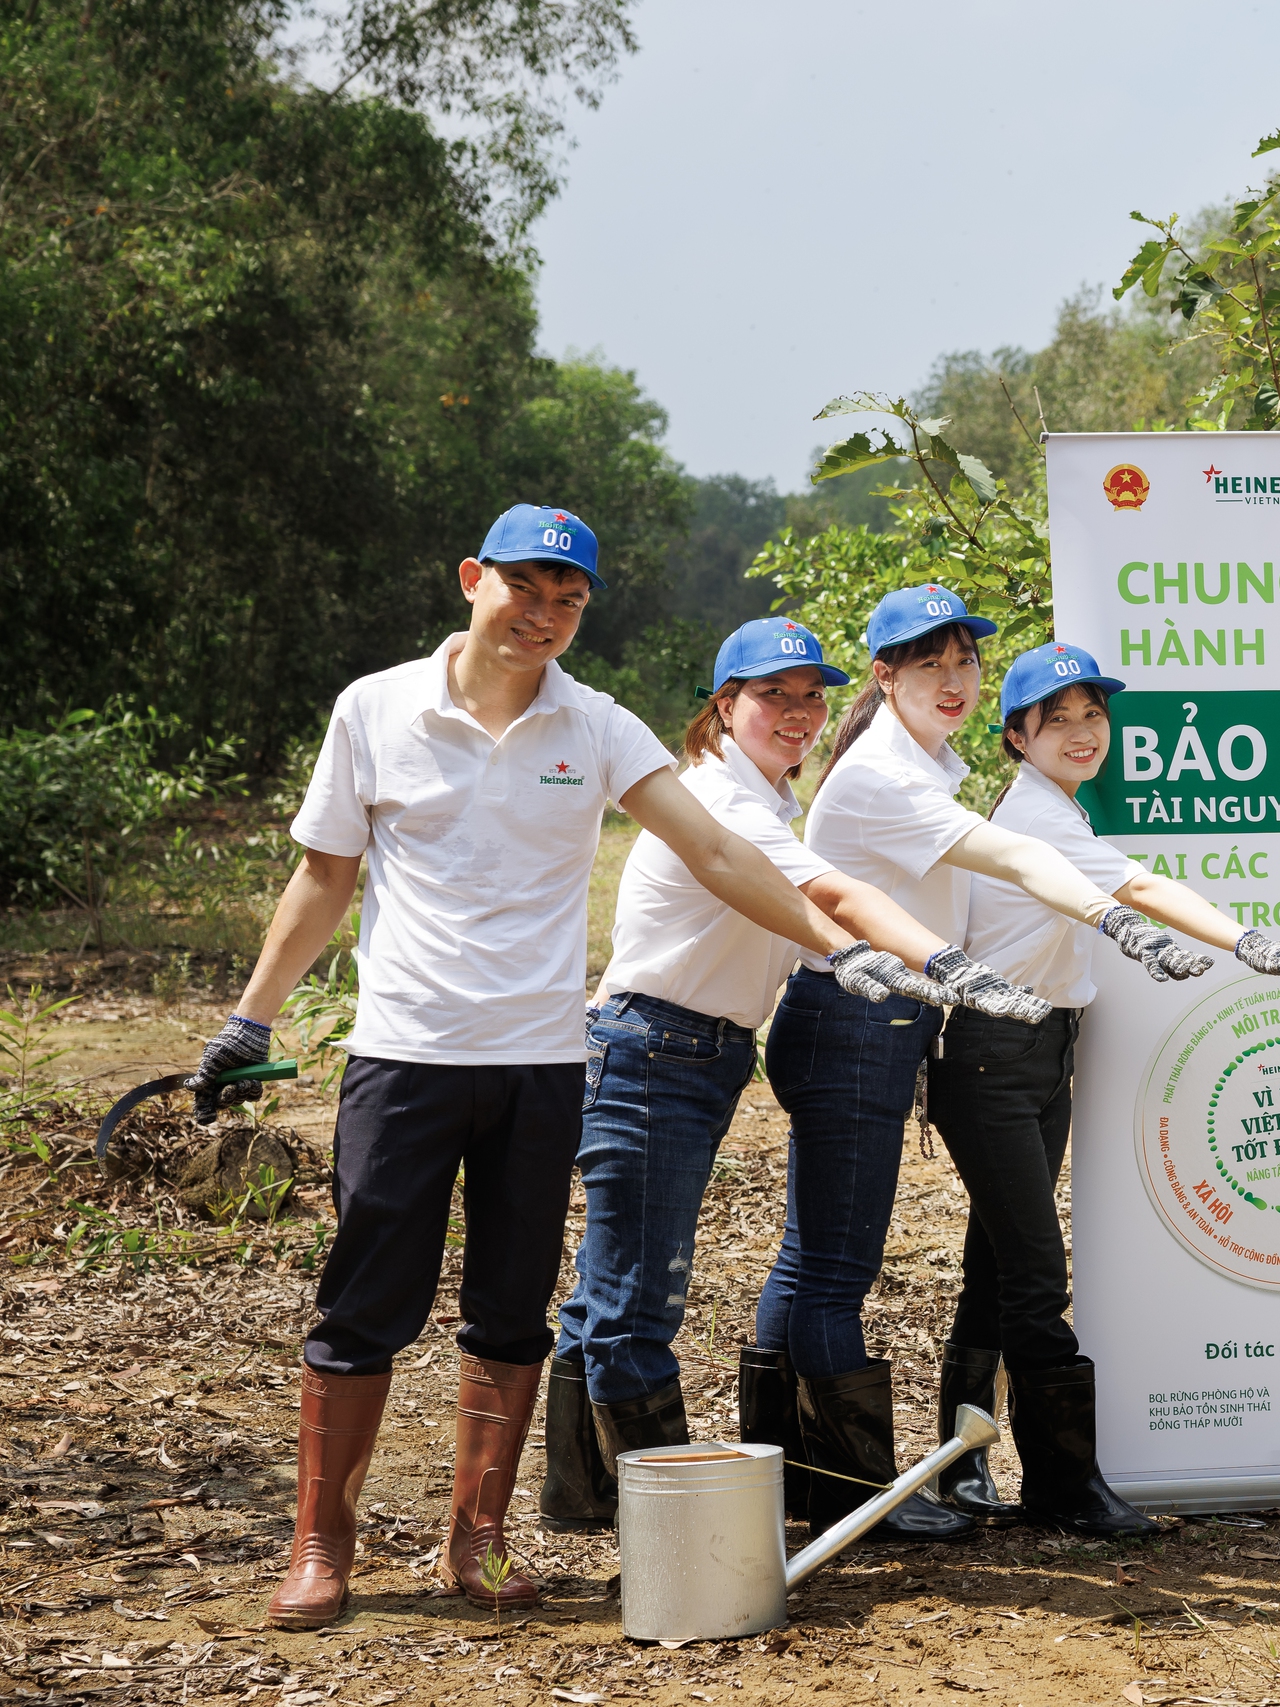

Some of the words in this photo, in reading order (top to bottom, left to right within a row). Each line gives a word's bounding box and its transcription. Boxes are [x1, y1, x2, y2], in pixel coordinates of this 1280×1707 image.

[542, 528, 572, 551] 0.0
[926, 600, 953, 617] 0.0
[780, 637, 807, 656] 0.0
[1120, 617, 1266, 667] HÀNH
[1054, 659, 1082, 677] 0.0
[1122, 701, 1268, 782] BẢO
[539, 775, 584, 786] Heineken
[1126, 789, 1184, 824] TÀI
[1201, 845, 1269, 880] CÁC
[1216, 1004, 1236, 1022] KINH
[1231, 1013, 1261, 1039] MÔI
[1168, 1065, 1183, 1083] THẢI
[1162, 1082, 1176, 1104] PHÁT
[1252, 1085, 1274, 1108] VÌ
[1159, 1116, 1169, 1129] ĐA
[1158, 1129, 1170, 1152] DẠNG
[1231, 1137, 1268, 1163] TỐT
[1163, 1159, 1178, 1181] CÔNG
[1246, 1167, 1271, 1182] NÂNG
[1182, 1201, 1191, 1210] &
[1192, 1179, 1217, 1204] XÃ
[1207, 1197, 1234, 1225] HỘI
[1186, 1208, 1200, 1220] AN
[1195, 1216, 1215, 1237] TOÀN
[1228, 1241, 1246, 1257] TRỢ
[1244, 1249, 1265, 1263] CỘNG
[1204, 1339, 1238, 1360] Đối
[1244, 1341, 1275, 1358] tác
[1149, 1393, 1168, 1404] BQL
[1170, 1390, 1199, 1402] RỪNG
[1201, 1388, 1237, 1400] PHÒNG
[1239, 1386, 1254, 1399] HỘ
[1256, 1386, 1270, 1398] VÀ
[1149, 1407, 1170, 1417] KHU
[1173, 1403, 1194, 1416] BẢO
[1220, 1403, 1245, 1414] SINH
[1246, 1400, 1271, 1412] THÁI
[1183, 1417, 1211, 1429] THÁP
[1213, 1415, 1243, 1427] MƯỜI
